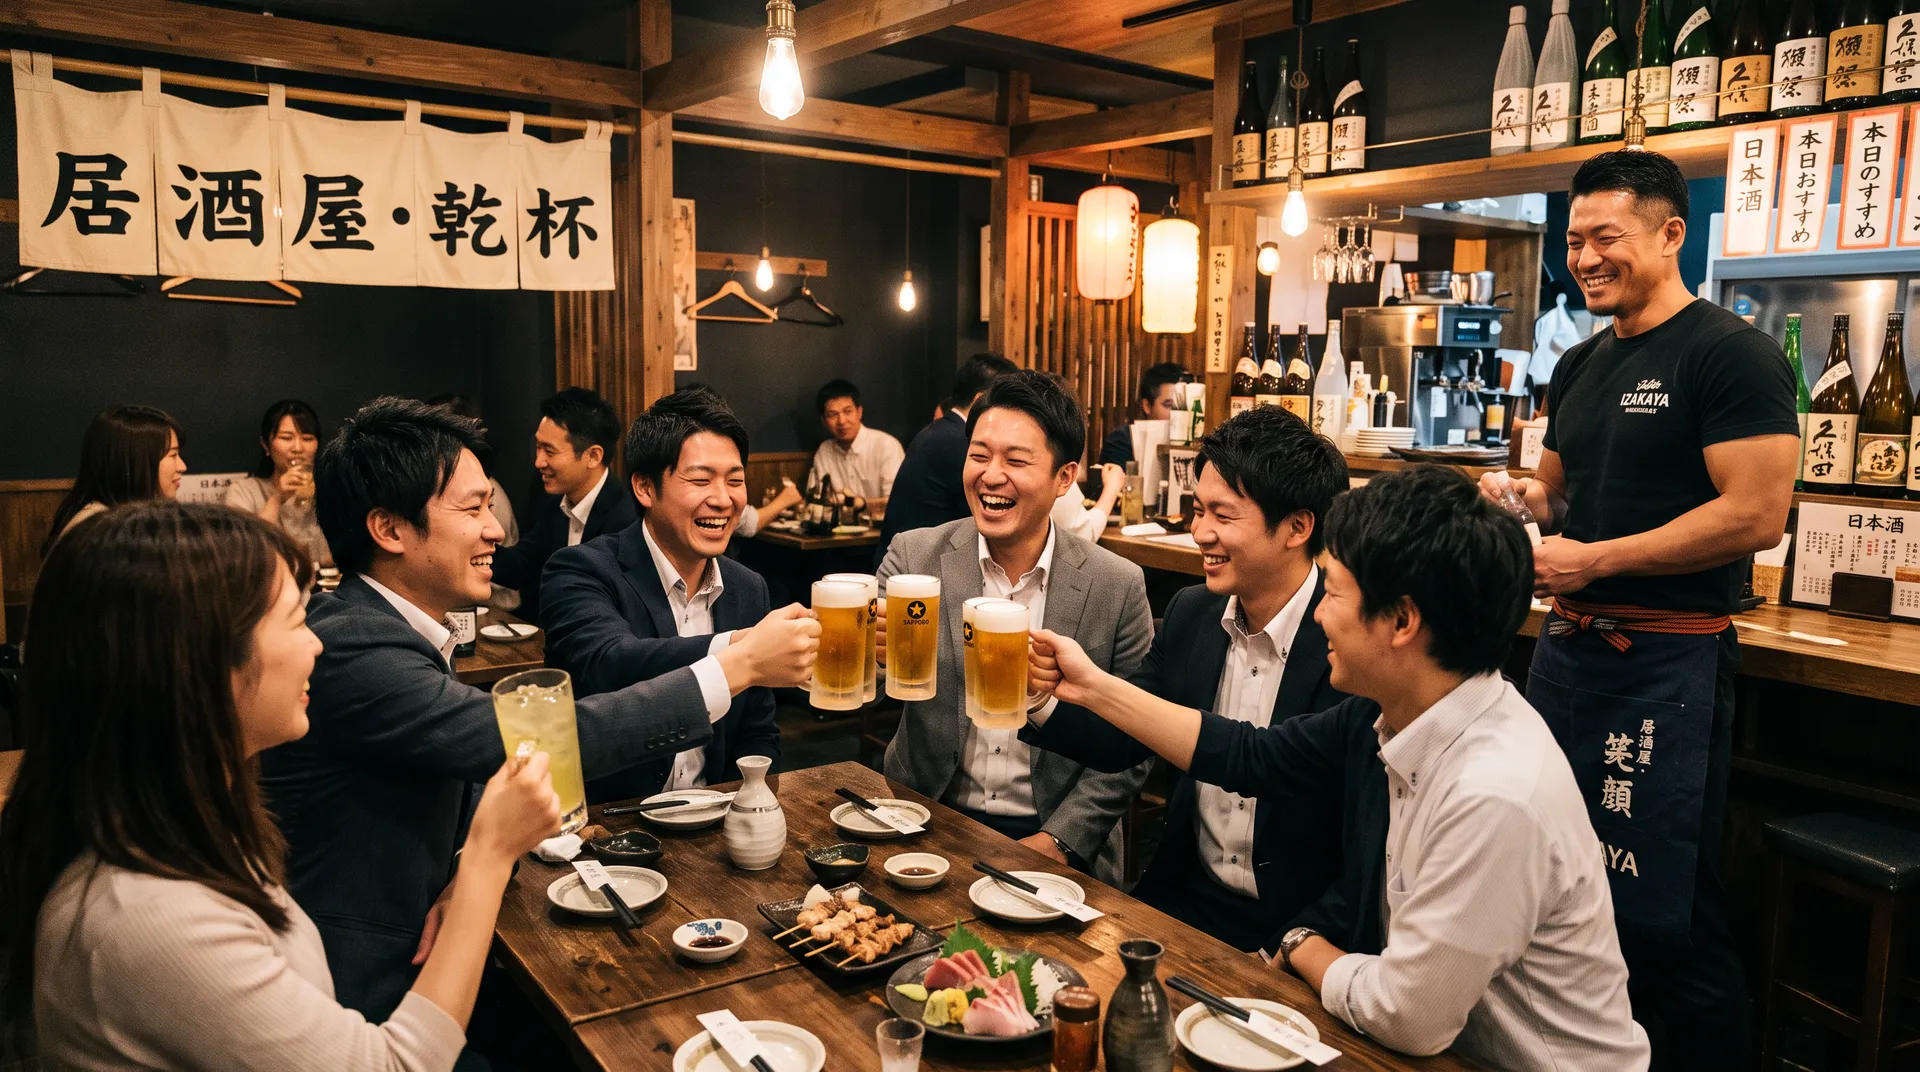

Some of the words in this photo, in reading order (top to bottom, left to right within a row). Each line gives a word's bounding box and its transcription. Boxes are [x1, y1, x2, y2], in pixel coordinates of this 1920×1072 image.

[1736, 138, 1766, 213] 日本酒
[1791, 129, 1823, 243] 本日おすすめ
[1854, 121, 1888, 239] 本日のすすめ
[1620, 392, 1669, 408] IZAKAYA
[1848, 513, 1904, 534] 日本酒
